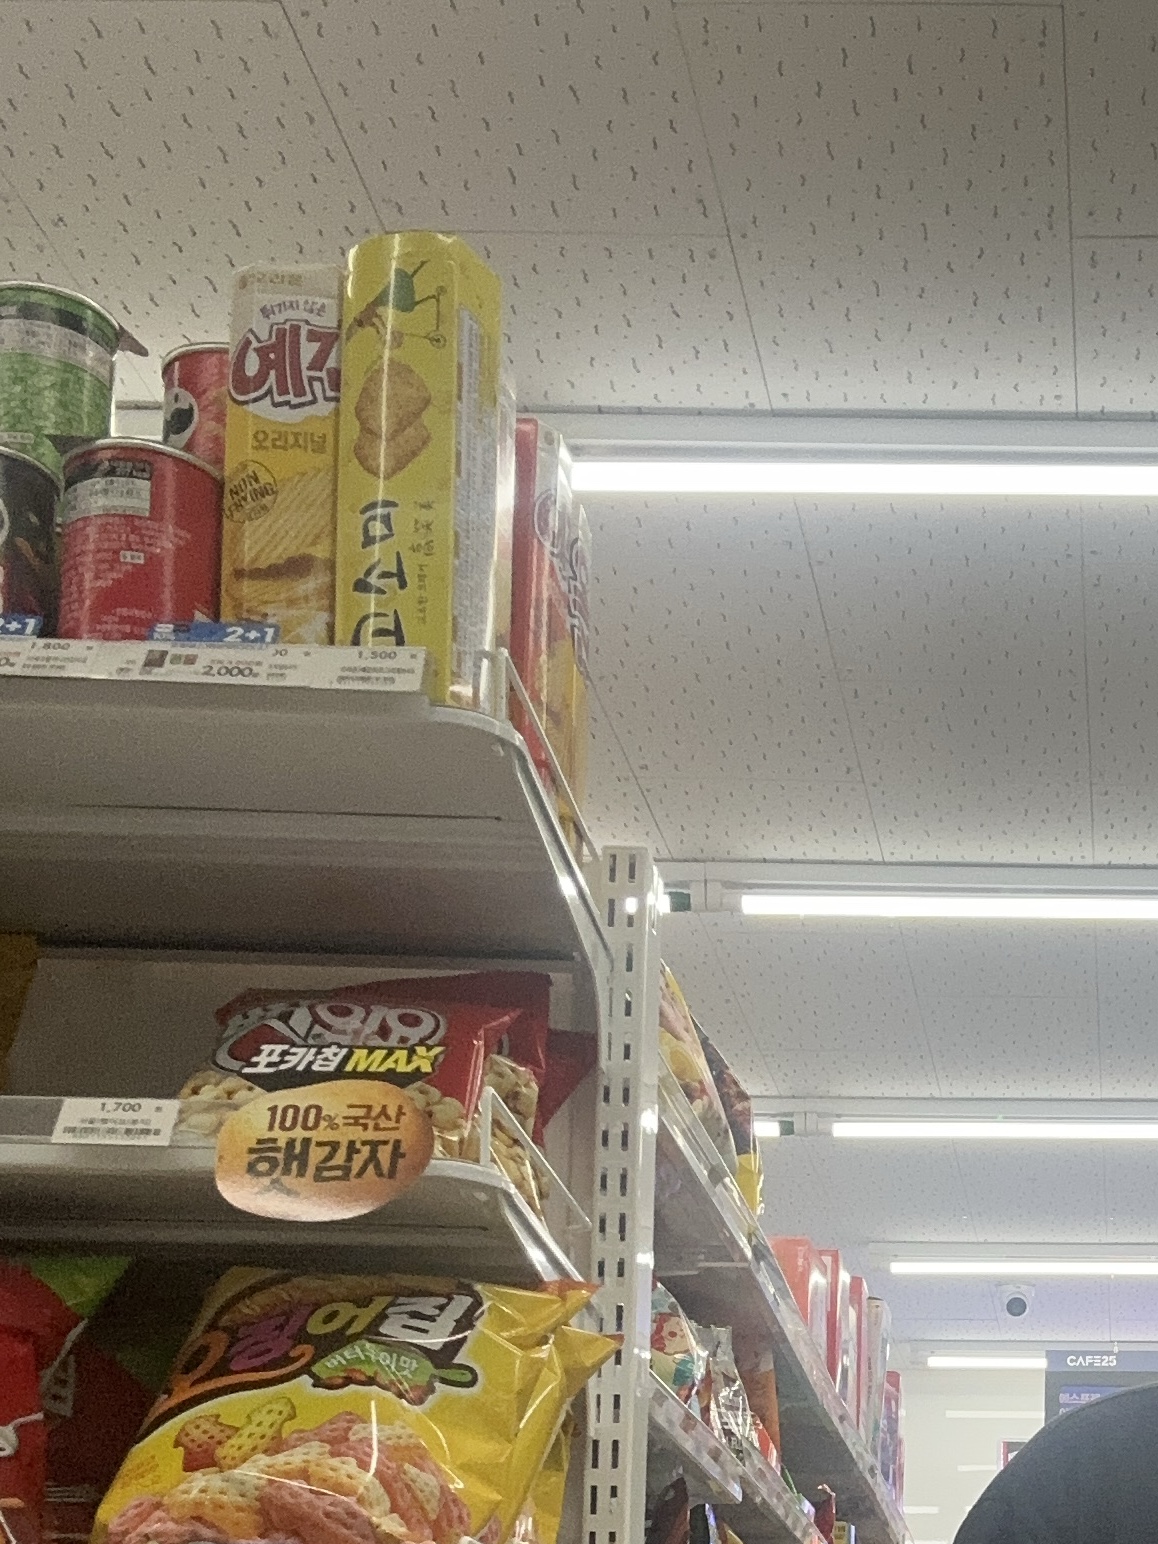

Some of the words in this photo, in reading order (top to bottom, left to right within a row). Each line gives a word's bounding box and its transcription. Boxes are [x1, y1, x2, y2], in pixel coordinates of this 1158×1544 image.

[252, 430, 327, 454] 오리지널
[223, 626, 276, 643] 2+1
[242, 1044, 348, 1073] 포카칩
[345, 1045, 445, 1073] MAX
[1066, 1355, 1117, 1367] CAFE25
